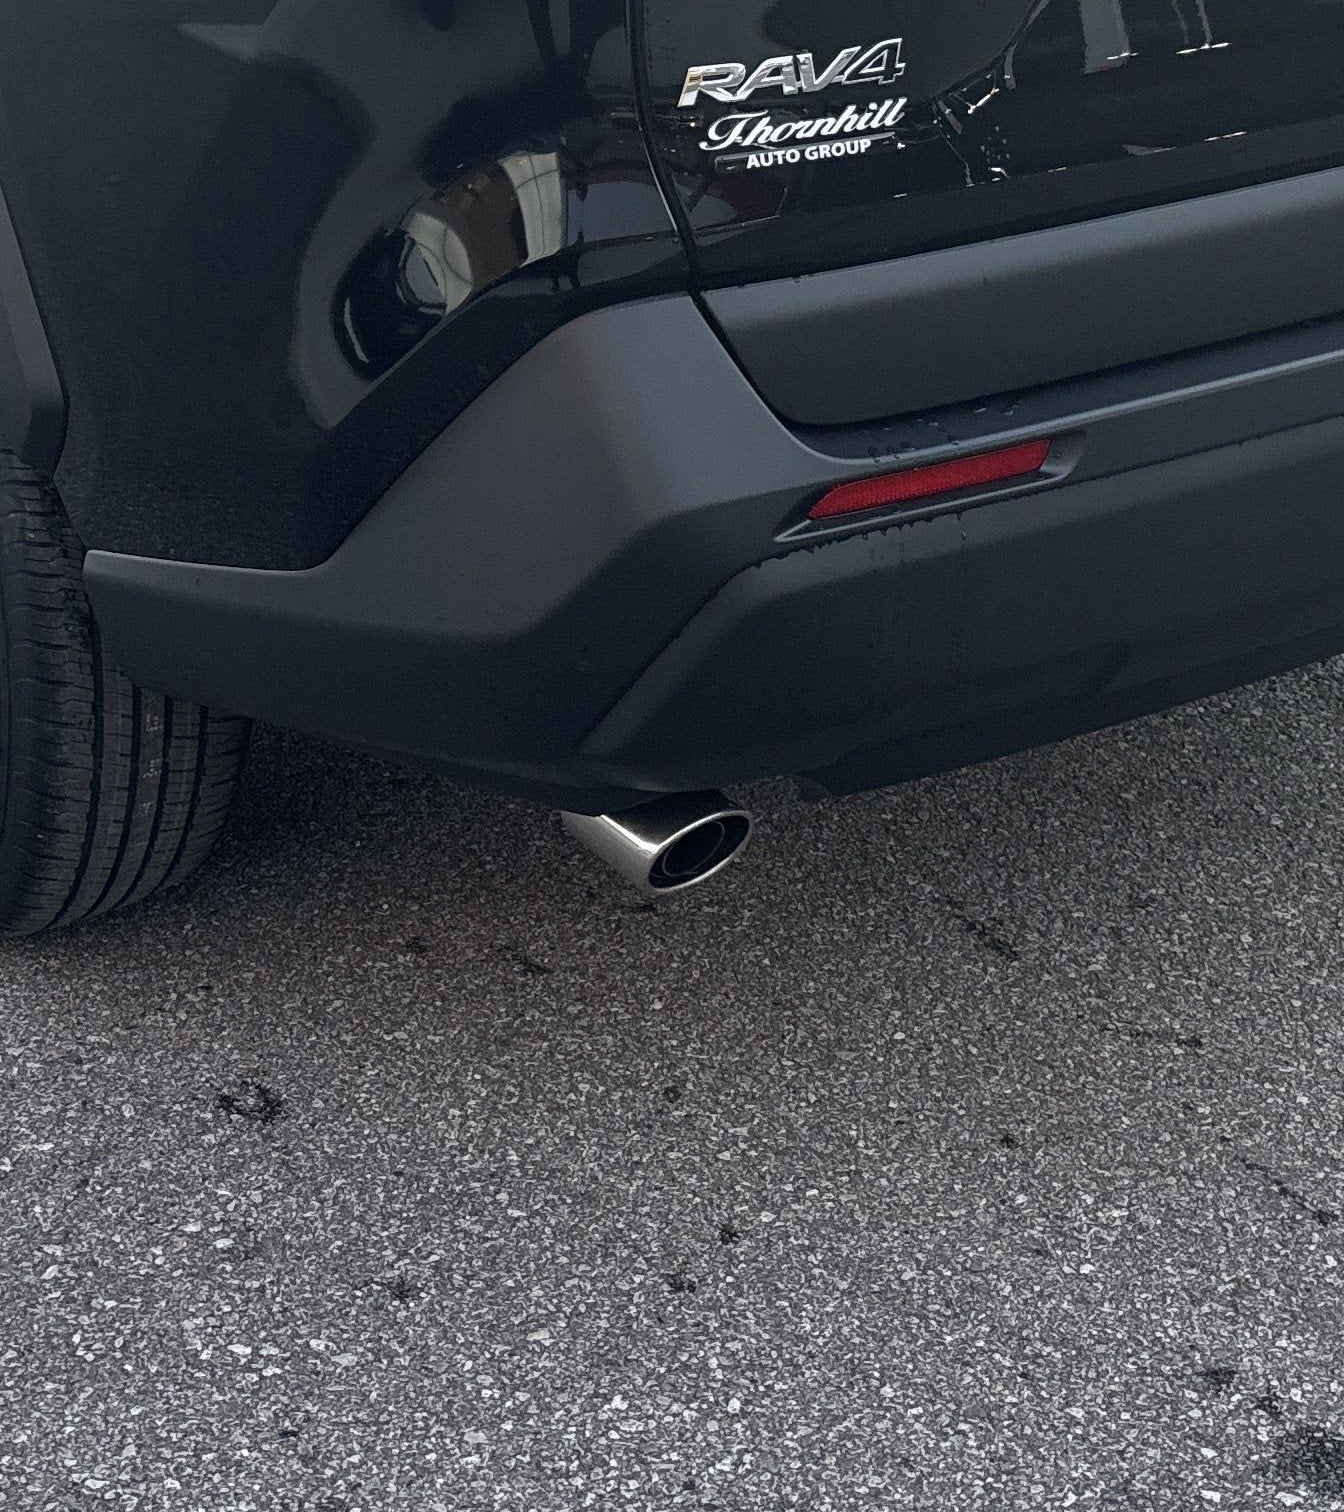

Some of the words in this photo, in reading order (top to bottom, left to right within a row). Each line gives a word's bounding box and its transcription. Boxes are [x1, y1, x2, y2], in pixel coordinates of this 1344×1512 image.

[677, 37, 906, 108] RAV4
[699, 96, 908, 151] Thornhill
[746, 148, 801, 170] AUTO
[804, 138, 872, 162] GROUP
